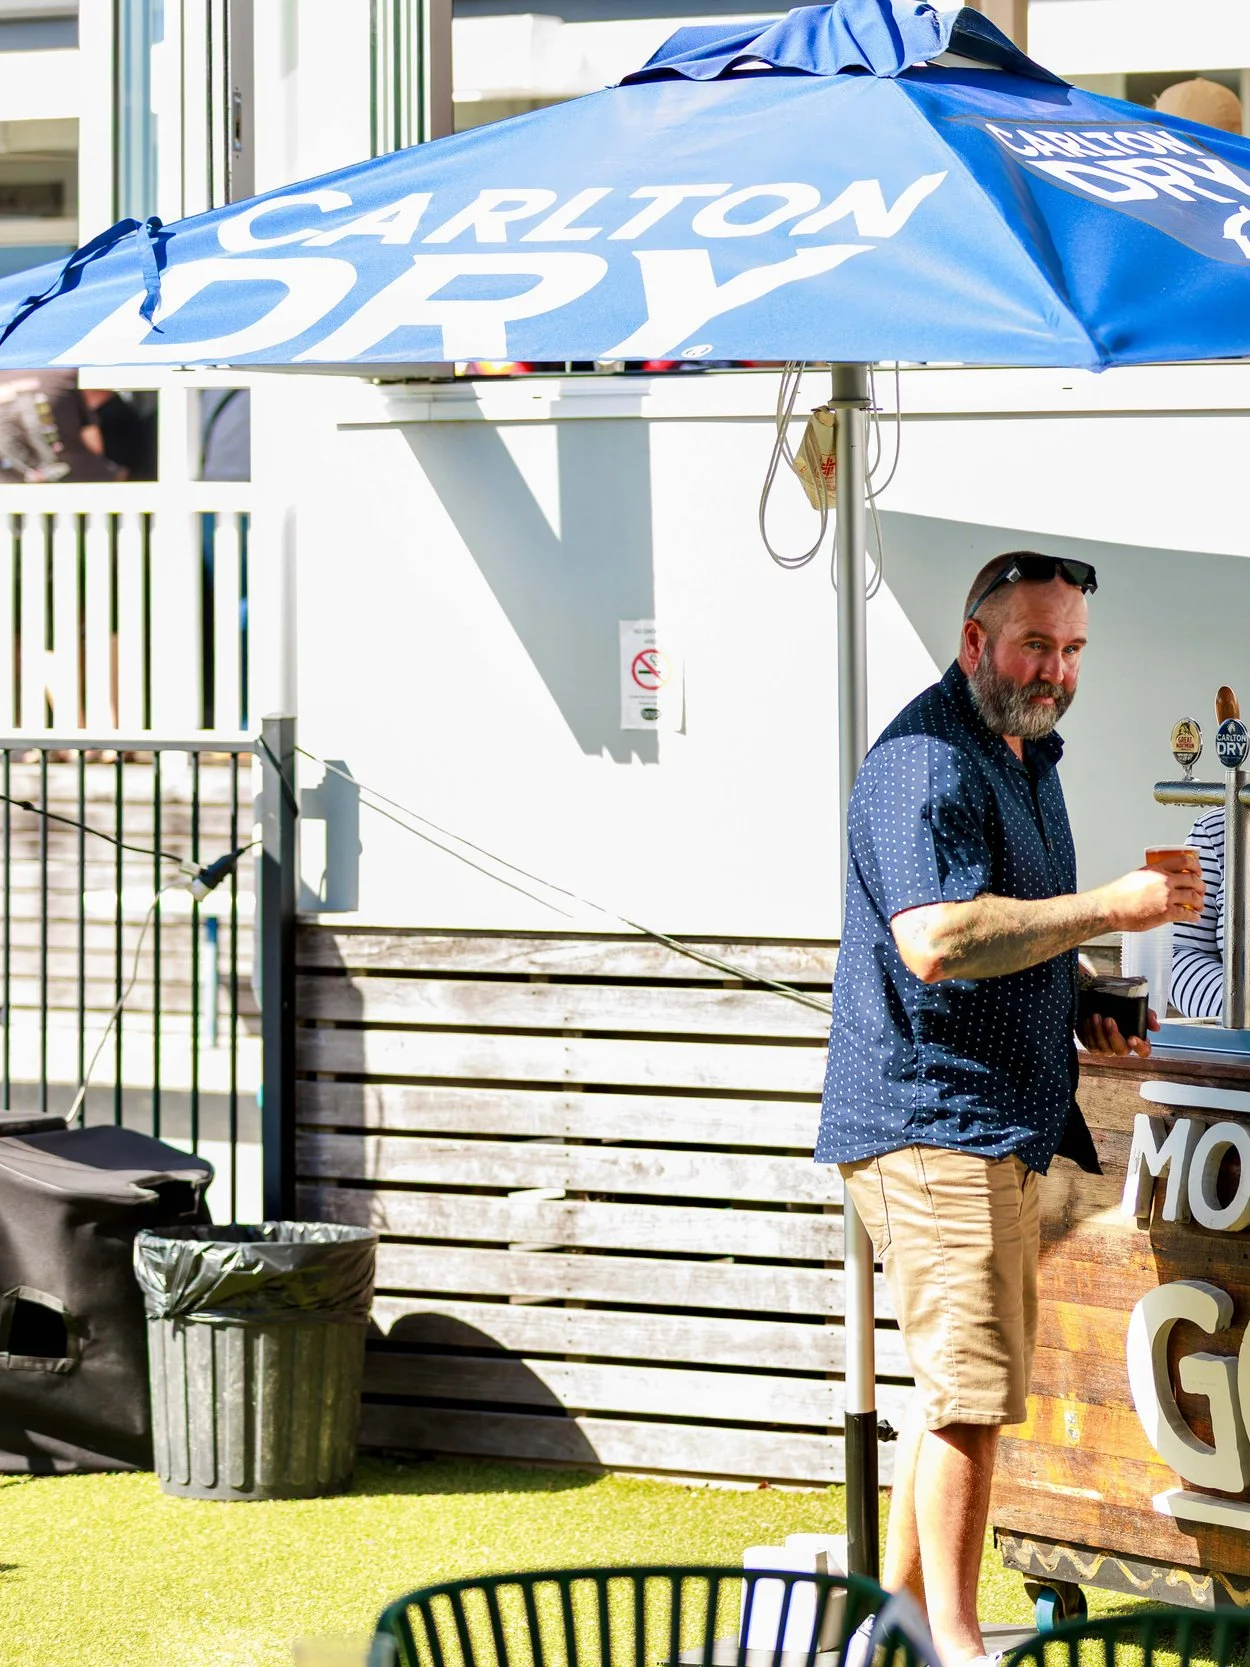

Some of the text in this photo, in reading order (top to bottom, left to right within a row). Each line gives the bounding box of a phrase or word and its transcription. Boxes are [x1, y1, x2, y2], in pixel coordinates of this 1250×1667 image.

[985, 124, 1205, 157] CARLTON
[217, 171, 949, 253] CARLTON
[48, 245, 877, 364] DRY
[1216, 733, 1248, 742] CARLTON
[1217, 741, 1247, 756] DRY
